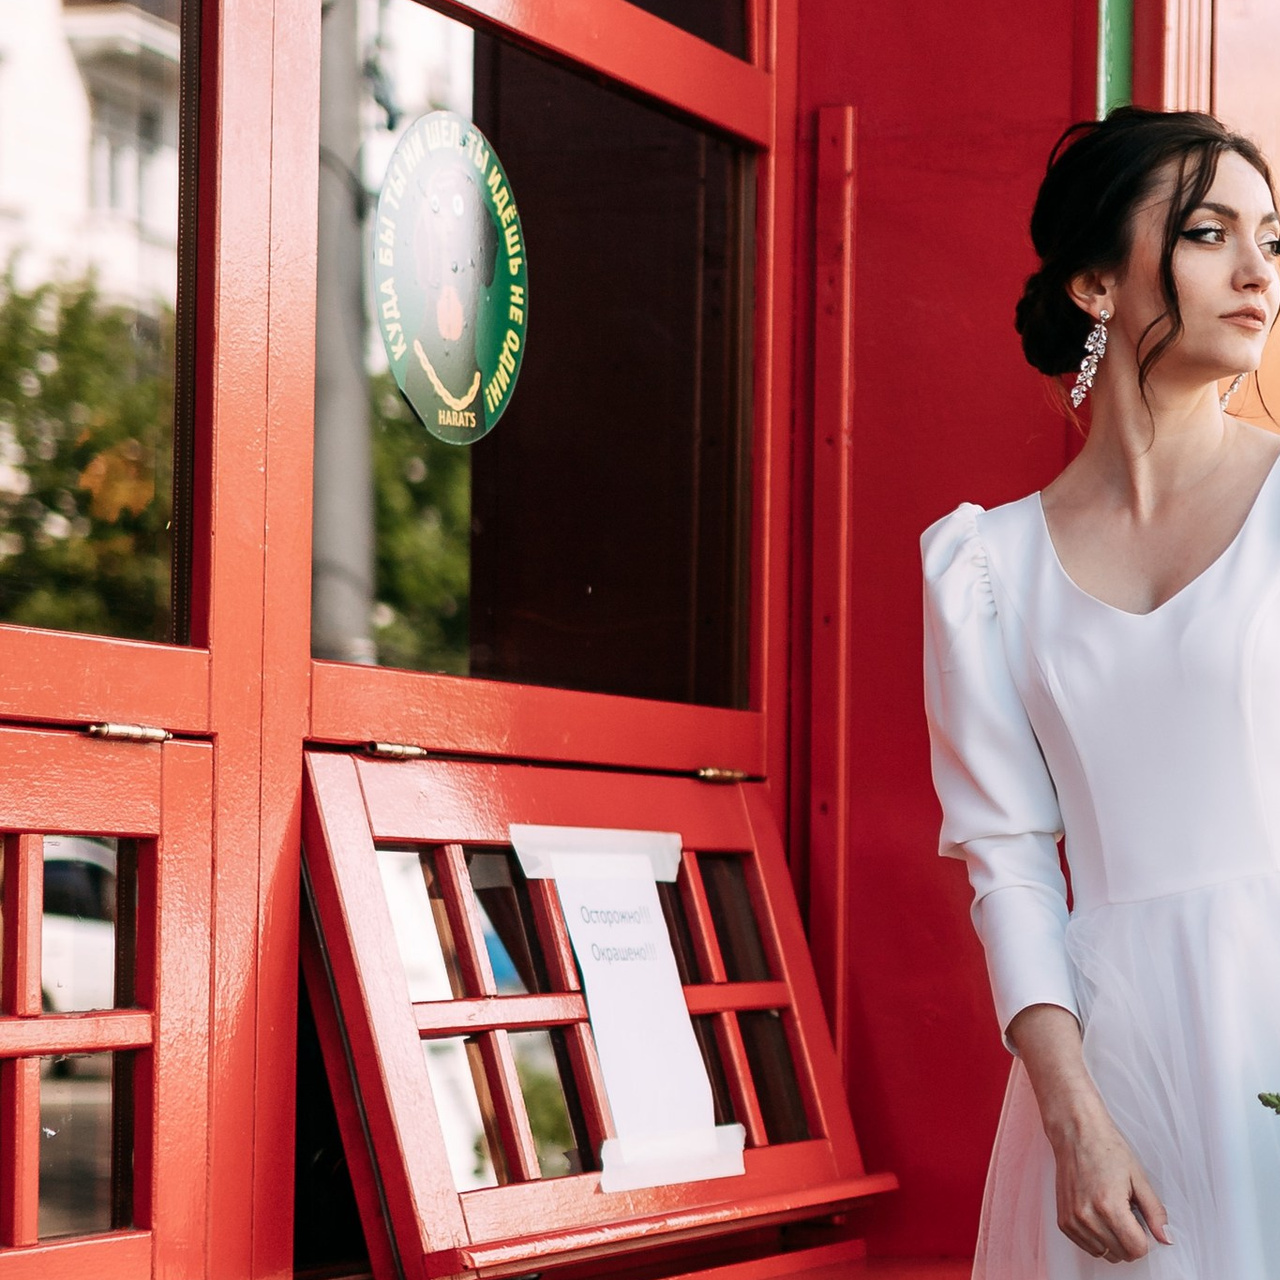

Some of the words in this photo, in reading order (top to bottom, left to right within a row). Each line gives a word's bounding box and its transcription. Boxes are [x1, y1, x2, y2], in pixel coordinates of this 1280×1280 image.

[402, 131, 425, 174] НИ
[466, 130, 489, 175] ТЫ
[384, 162, 407, 210] ТЫ
[379, 216, 396, 267] БЫ
[487, 165, 522, 276] ИДЁШЬ
[380, 277, 407, 361] КУДА
[509, 285, 524, 325] НЕ
[485, 329, 520, 413] ОДИН!
[580, 905, 653, 928] Осторожно!!!
[591, 942, 657, 966] Окрашено!!!
